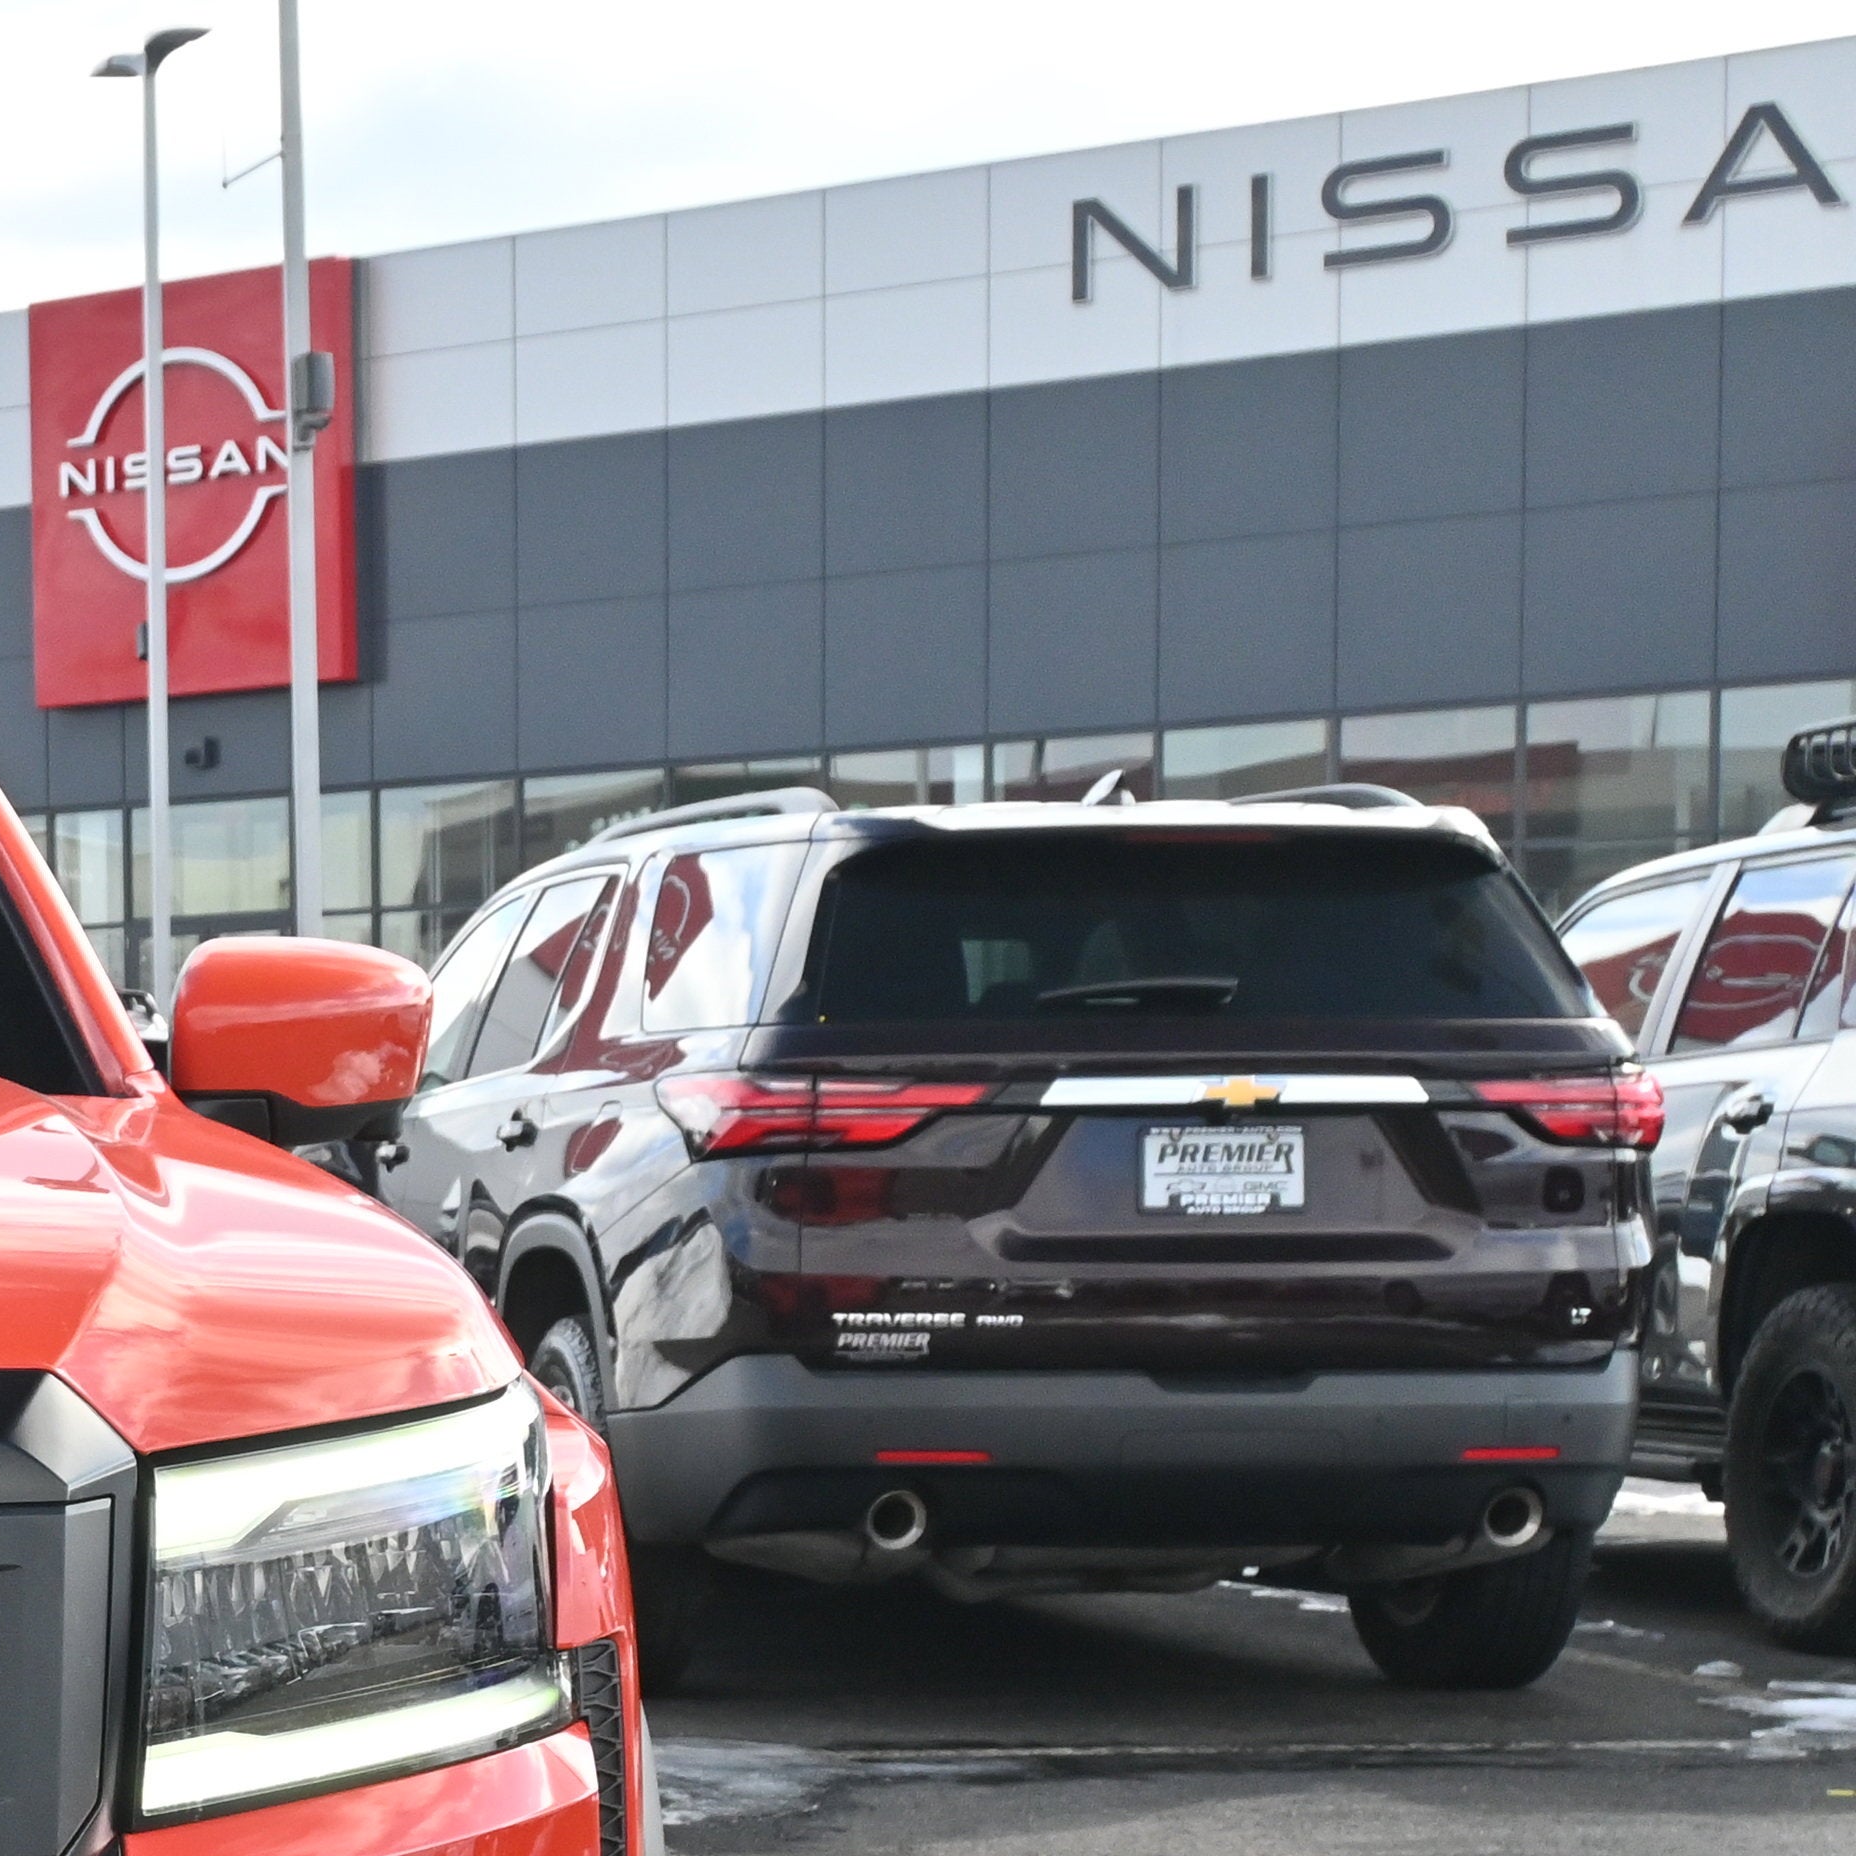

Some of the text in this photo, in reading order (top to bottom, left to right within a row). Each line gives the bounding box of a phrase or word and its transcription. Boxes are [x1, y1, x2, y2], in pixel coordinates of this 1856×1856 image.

[1070, 101, 1850, 305] NISSA
[58, 435, 289, 499] NISSAN
[1157, 1142, 1295, 1174] PREMIER
[1179, 1192, 1272, 1206] PREMIER
[832, 1312, 1024, 1327] TRAVERSE AWD
[837, 1332, 931, 1354] PREMIER
